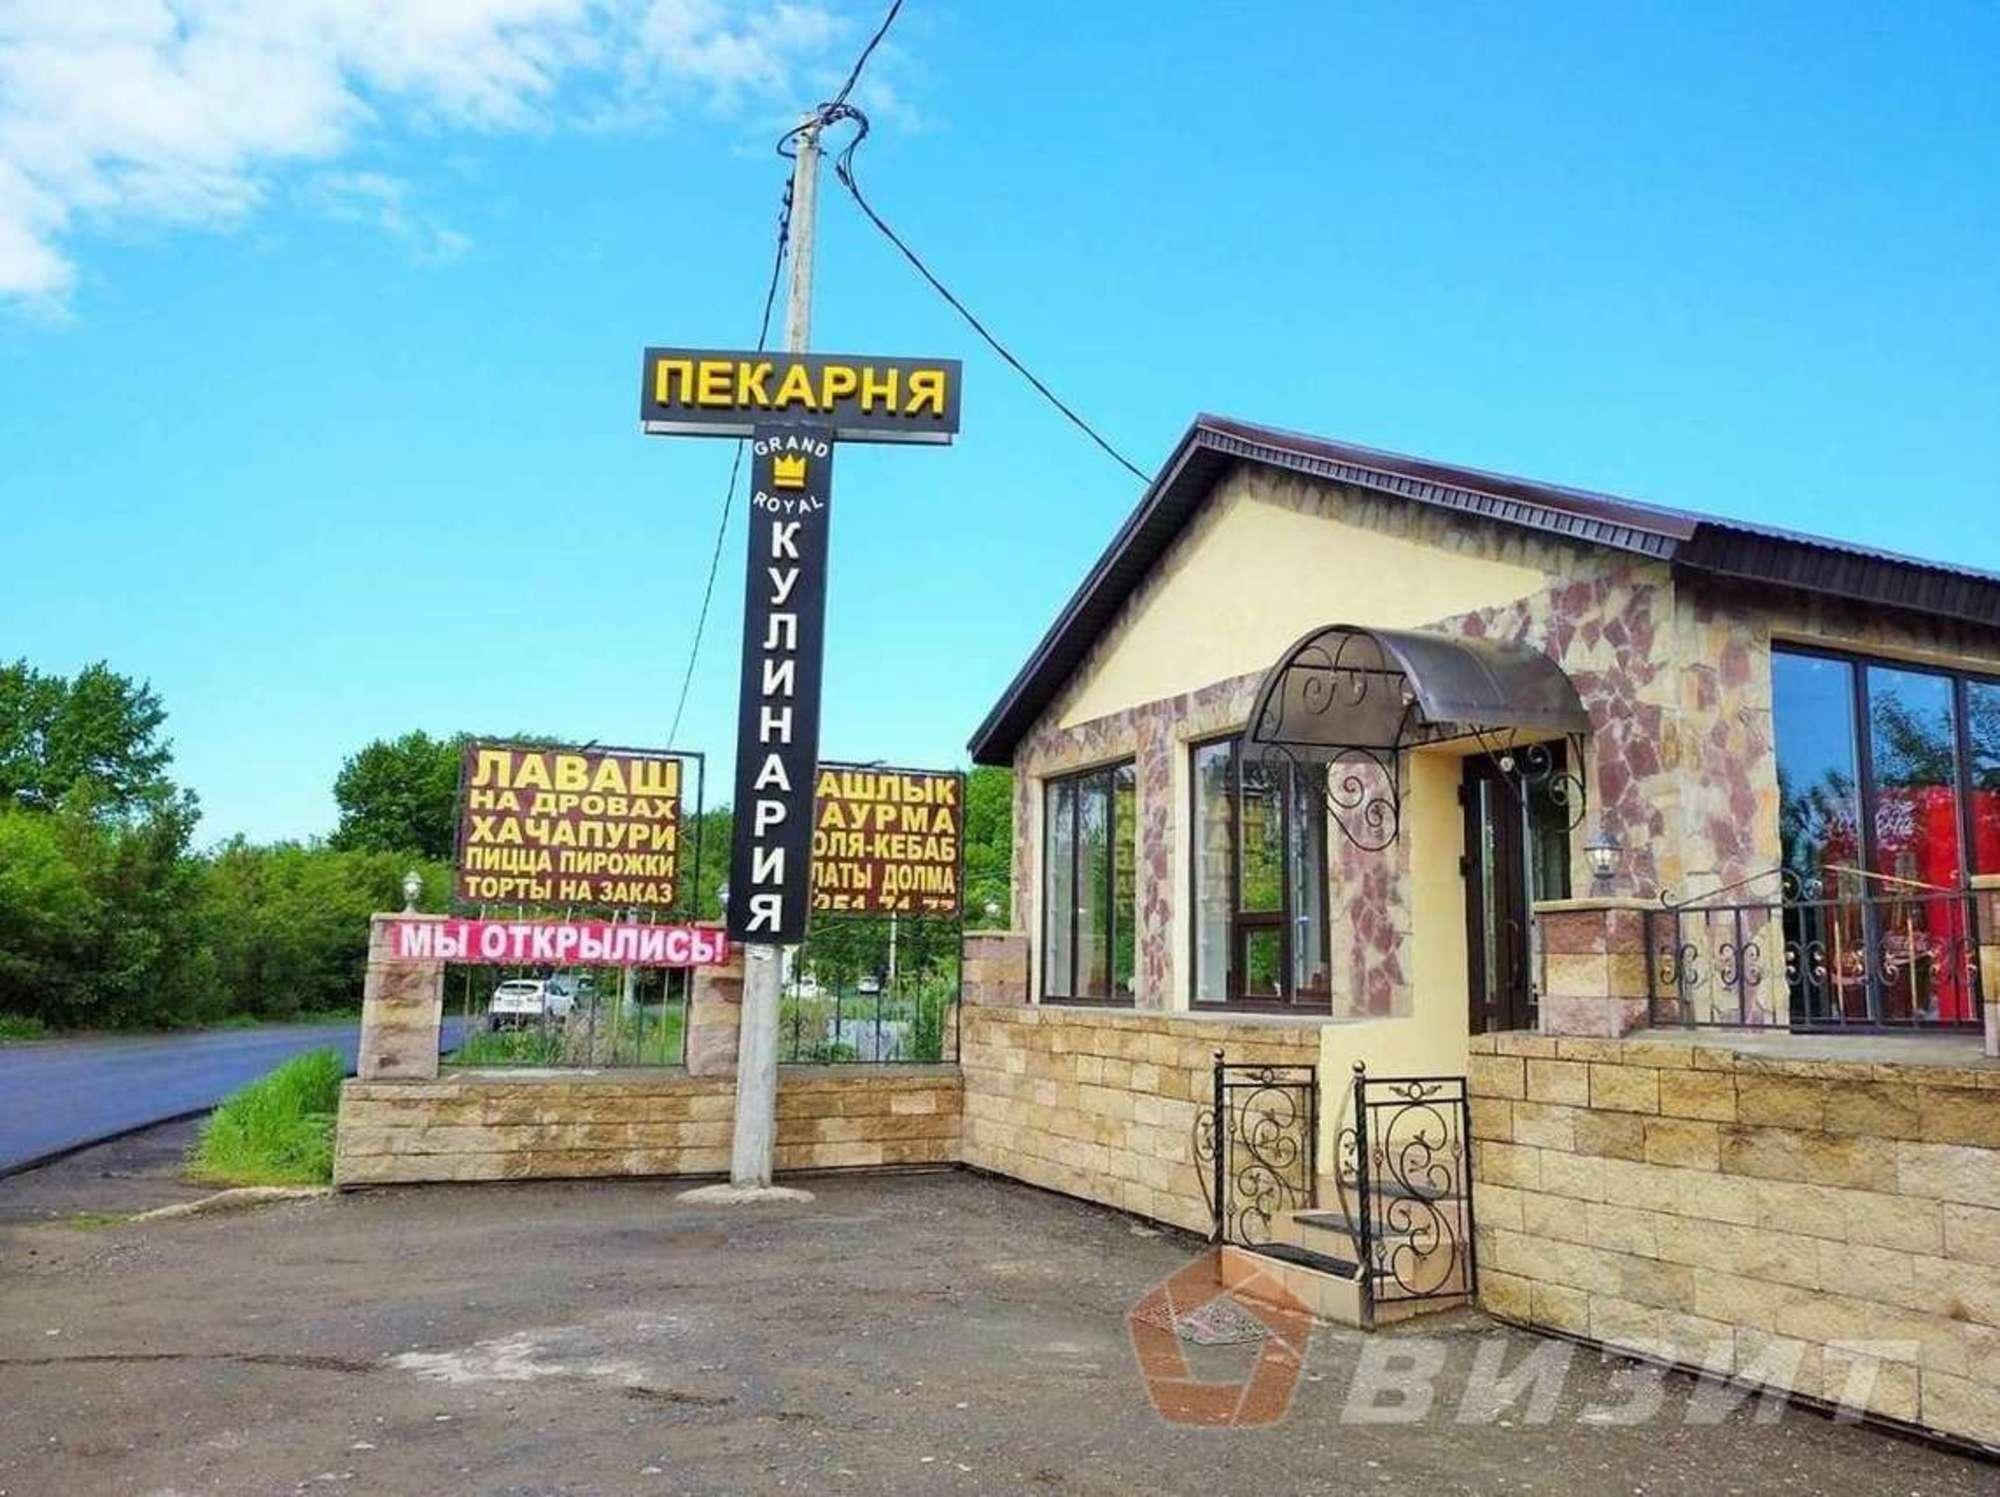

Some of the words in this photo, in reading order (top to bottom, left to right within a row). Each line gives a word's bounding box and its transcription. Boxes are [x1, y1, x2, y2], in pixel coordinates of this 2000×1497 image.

[655, 359, 945, 416] ПЕКАРНЯ
[754, 435, 828, 458] GRAND
[752, 491, 824, 514] ROYAL
[745, 521, 800, 932] КУЛИНАРИЯ
[471, 750, 679, 797] ЛАВАШ
[816, 772, 956, 804] АШЛЫК
[469, 788, 520, 812] НА
[530, 793, 675, 819] ДРОВАХ
[819, 801, 956, 834] АУРМА
[469, 815, 675, 851] ХАЧАПУРИ
[465, 847, 552, 876] ПИЦЦА
[560, 850, 674, 877] ПИРОЖКИ
[812, 861, 872, 889] ЛАТЫ
[882, 863, 956, 896] ДОЛМА
[464, 876, 552, 900] ТОРТЫ
[560, 879, 592, 902] НА
[600, 881, 673, 904] ЗАКАЗ
[400, 922, 469, 959] МЫ
[480, 923, 726, 963] ОТКРЫЛИСЬ!
